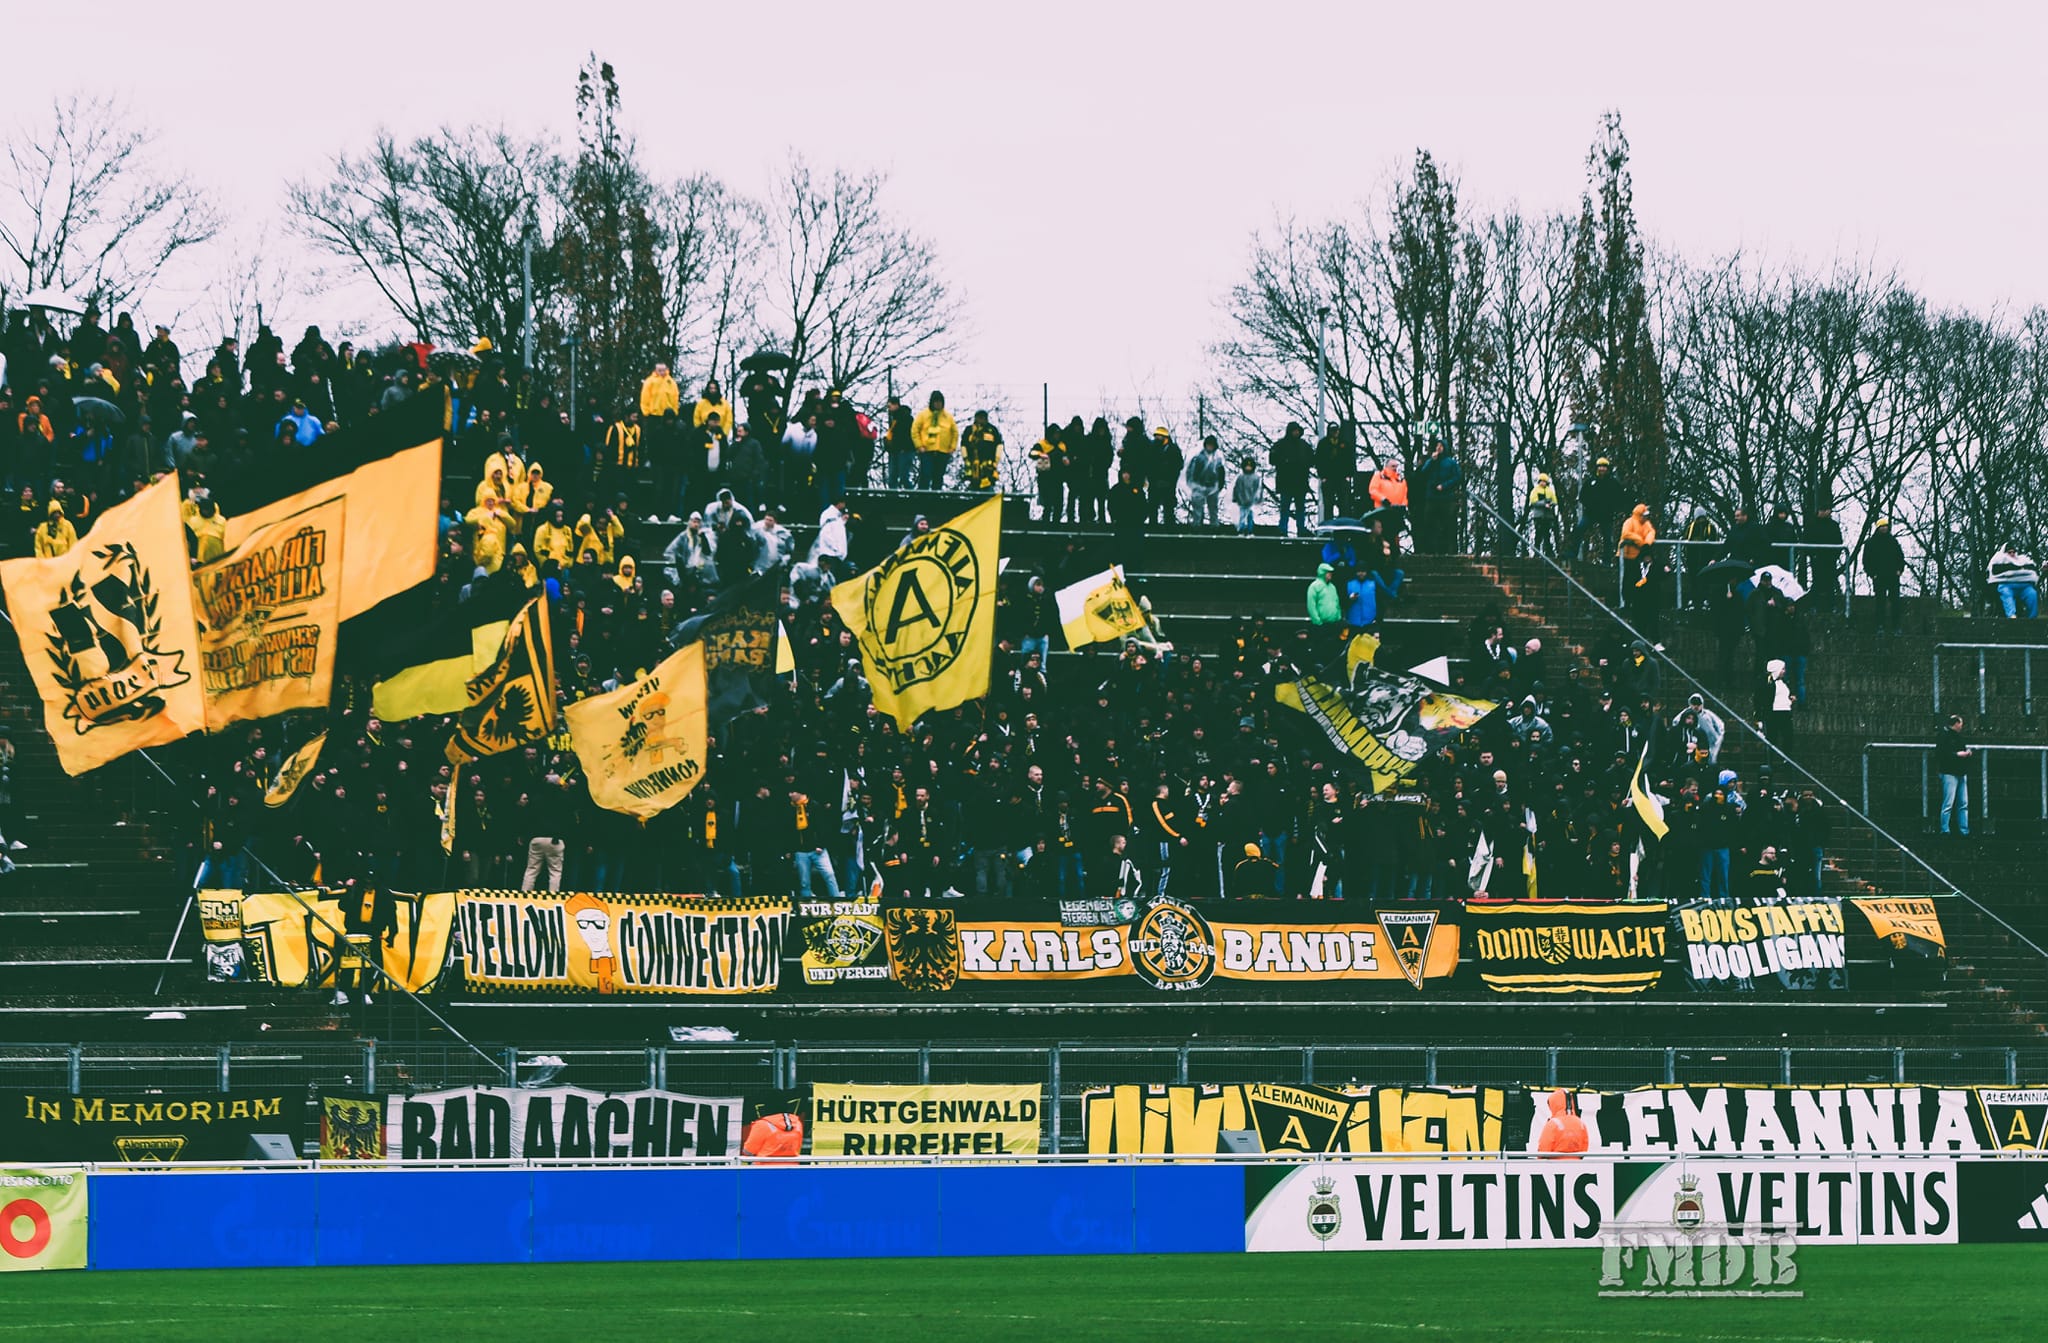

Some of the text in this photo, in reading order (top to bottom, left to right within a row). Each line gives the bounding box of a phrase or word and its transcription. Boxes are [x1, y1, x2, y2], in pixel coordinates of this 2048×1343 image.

[800, 900, 880, 916] FÜR STADT
[1059, 900, 1114, 912] LEGENDEN
[1062, 912, 1099, 924] STERBEN
[1383, 914, 1432, 924] ALEMANNIA
[460, 901, 566, 978] YELLOW
[620, 911, 787, 988] CONNECTION
[960, 929, 1123, 972] KARLS
[1222, 929, 1378, 972] BANDE
[1401, 925, 1420, 947] A
[1477, 926, 1666, 960] DOM WACHT
[808, 966, 888, 980] UND VEREIN
[1155, 978, 1200, 991] BANDE
[24, 1095, 283, 1126] IN MEMORIAM
[816, 1095, 1037, 1124] HÜRTGENWALD
[1252, 1084, 1339, 1118] ALEMANNIA
[1986, 1093, 2048, 1103] ALEMANNIA
[403, 1093, 730, 1166] BAD AACHEN
[1279, 1115, 1311, 1150] A
[2008, 1109, 2032, 1141] A
[843, 1132, 1012, 1156] RUREIFEL
[1354, 1173, 1601, 1241] VELTINS
[1717, 1171, 1950, 1237] VELTINS
